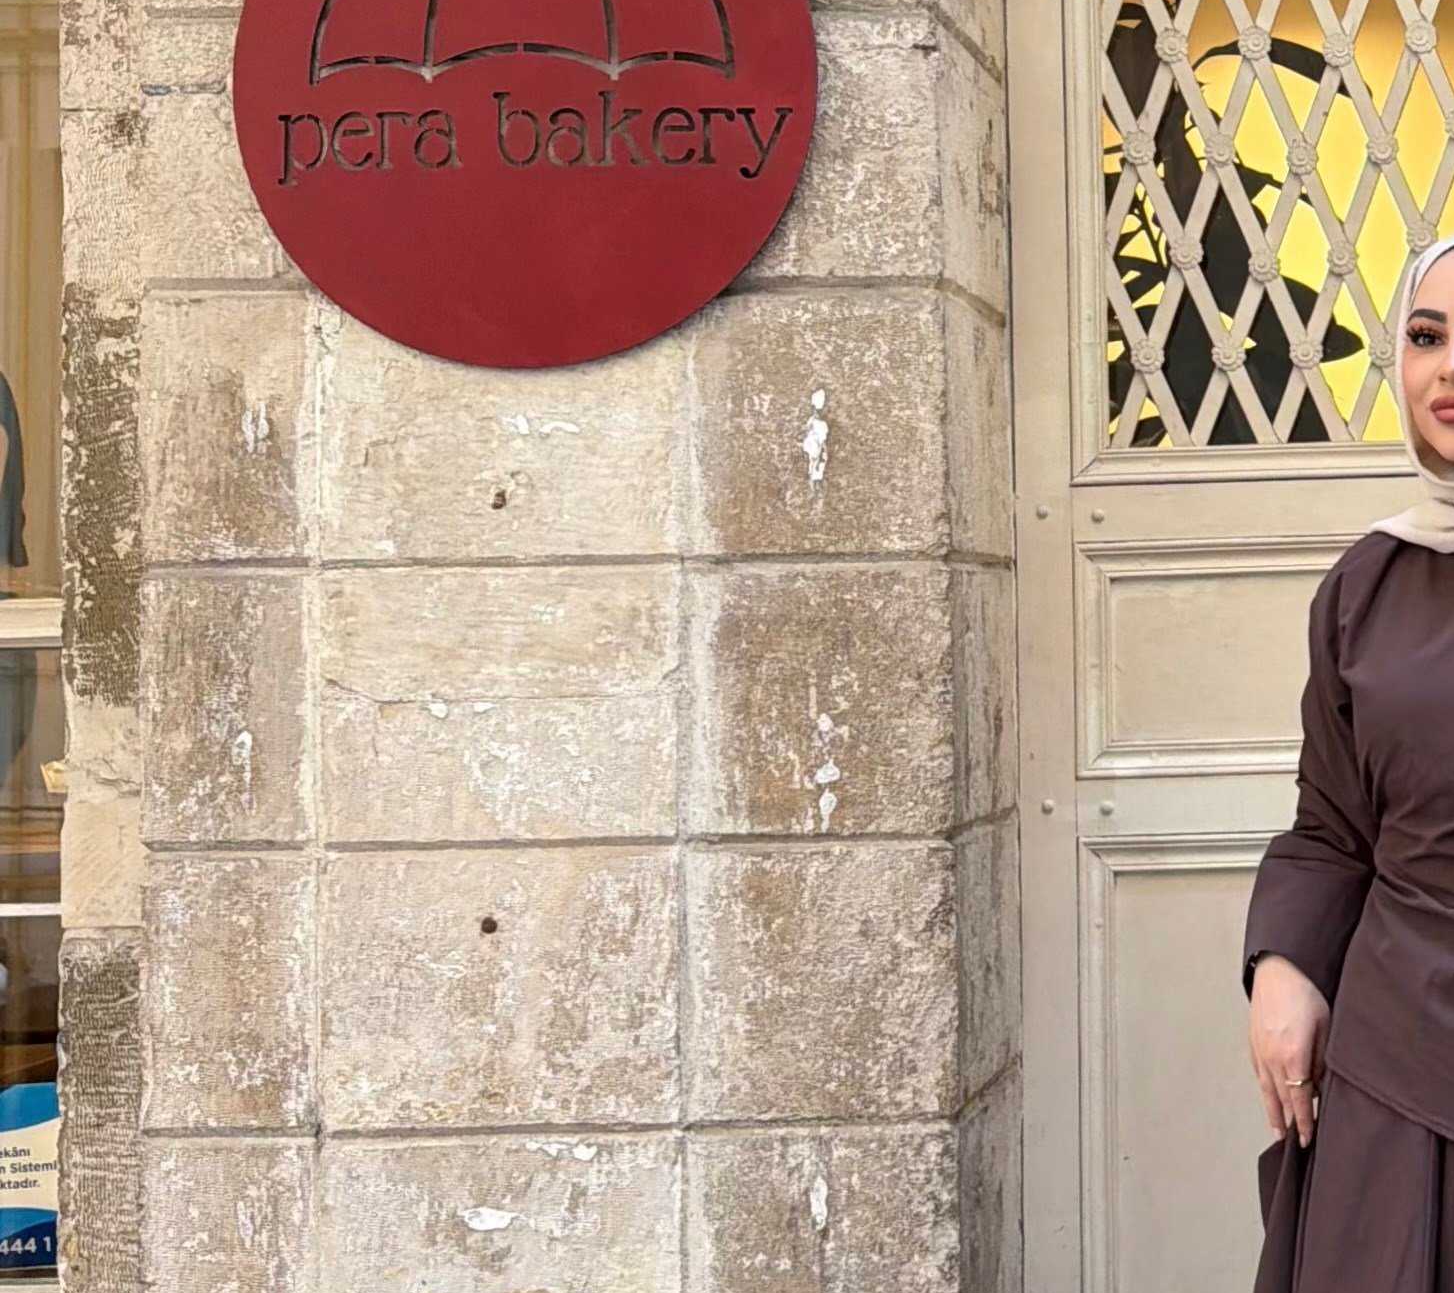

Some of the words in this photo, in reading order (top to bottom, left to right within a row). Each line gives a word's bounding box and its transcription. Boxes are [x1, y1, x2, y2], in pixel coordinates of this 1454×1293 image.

[277, 109, 463, 187] pera
[492, 90, 794, 180] bakery
[10, 1160, 57, 1174] Sistemi
[0, 1237, 37, 1255] 444
